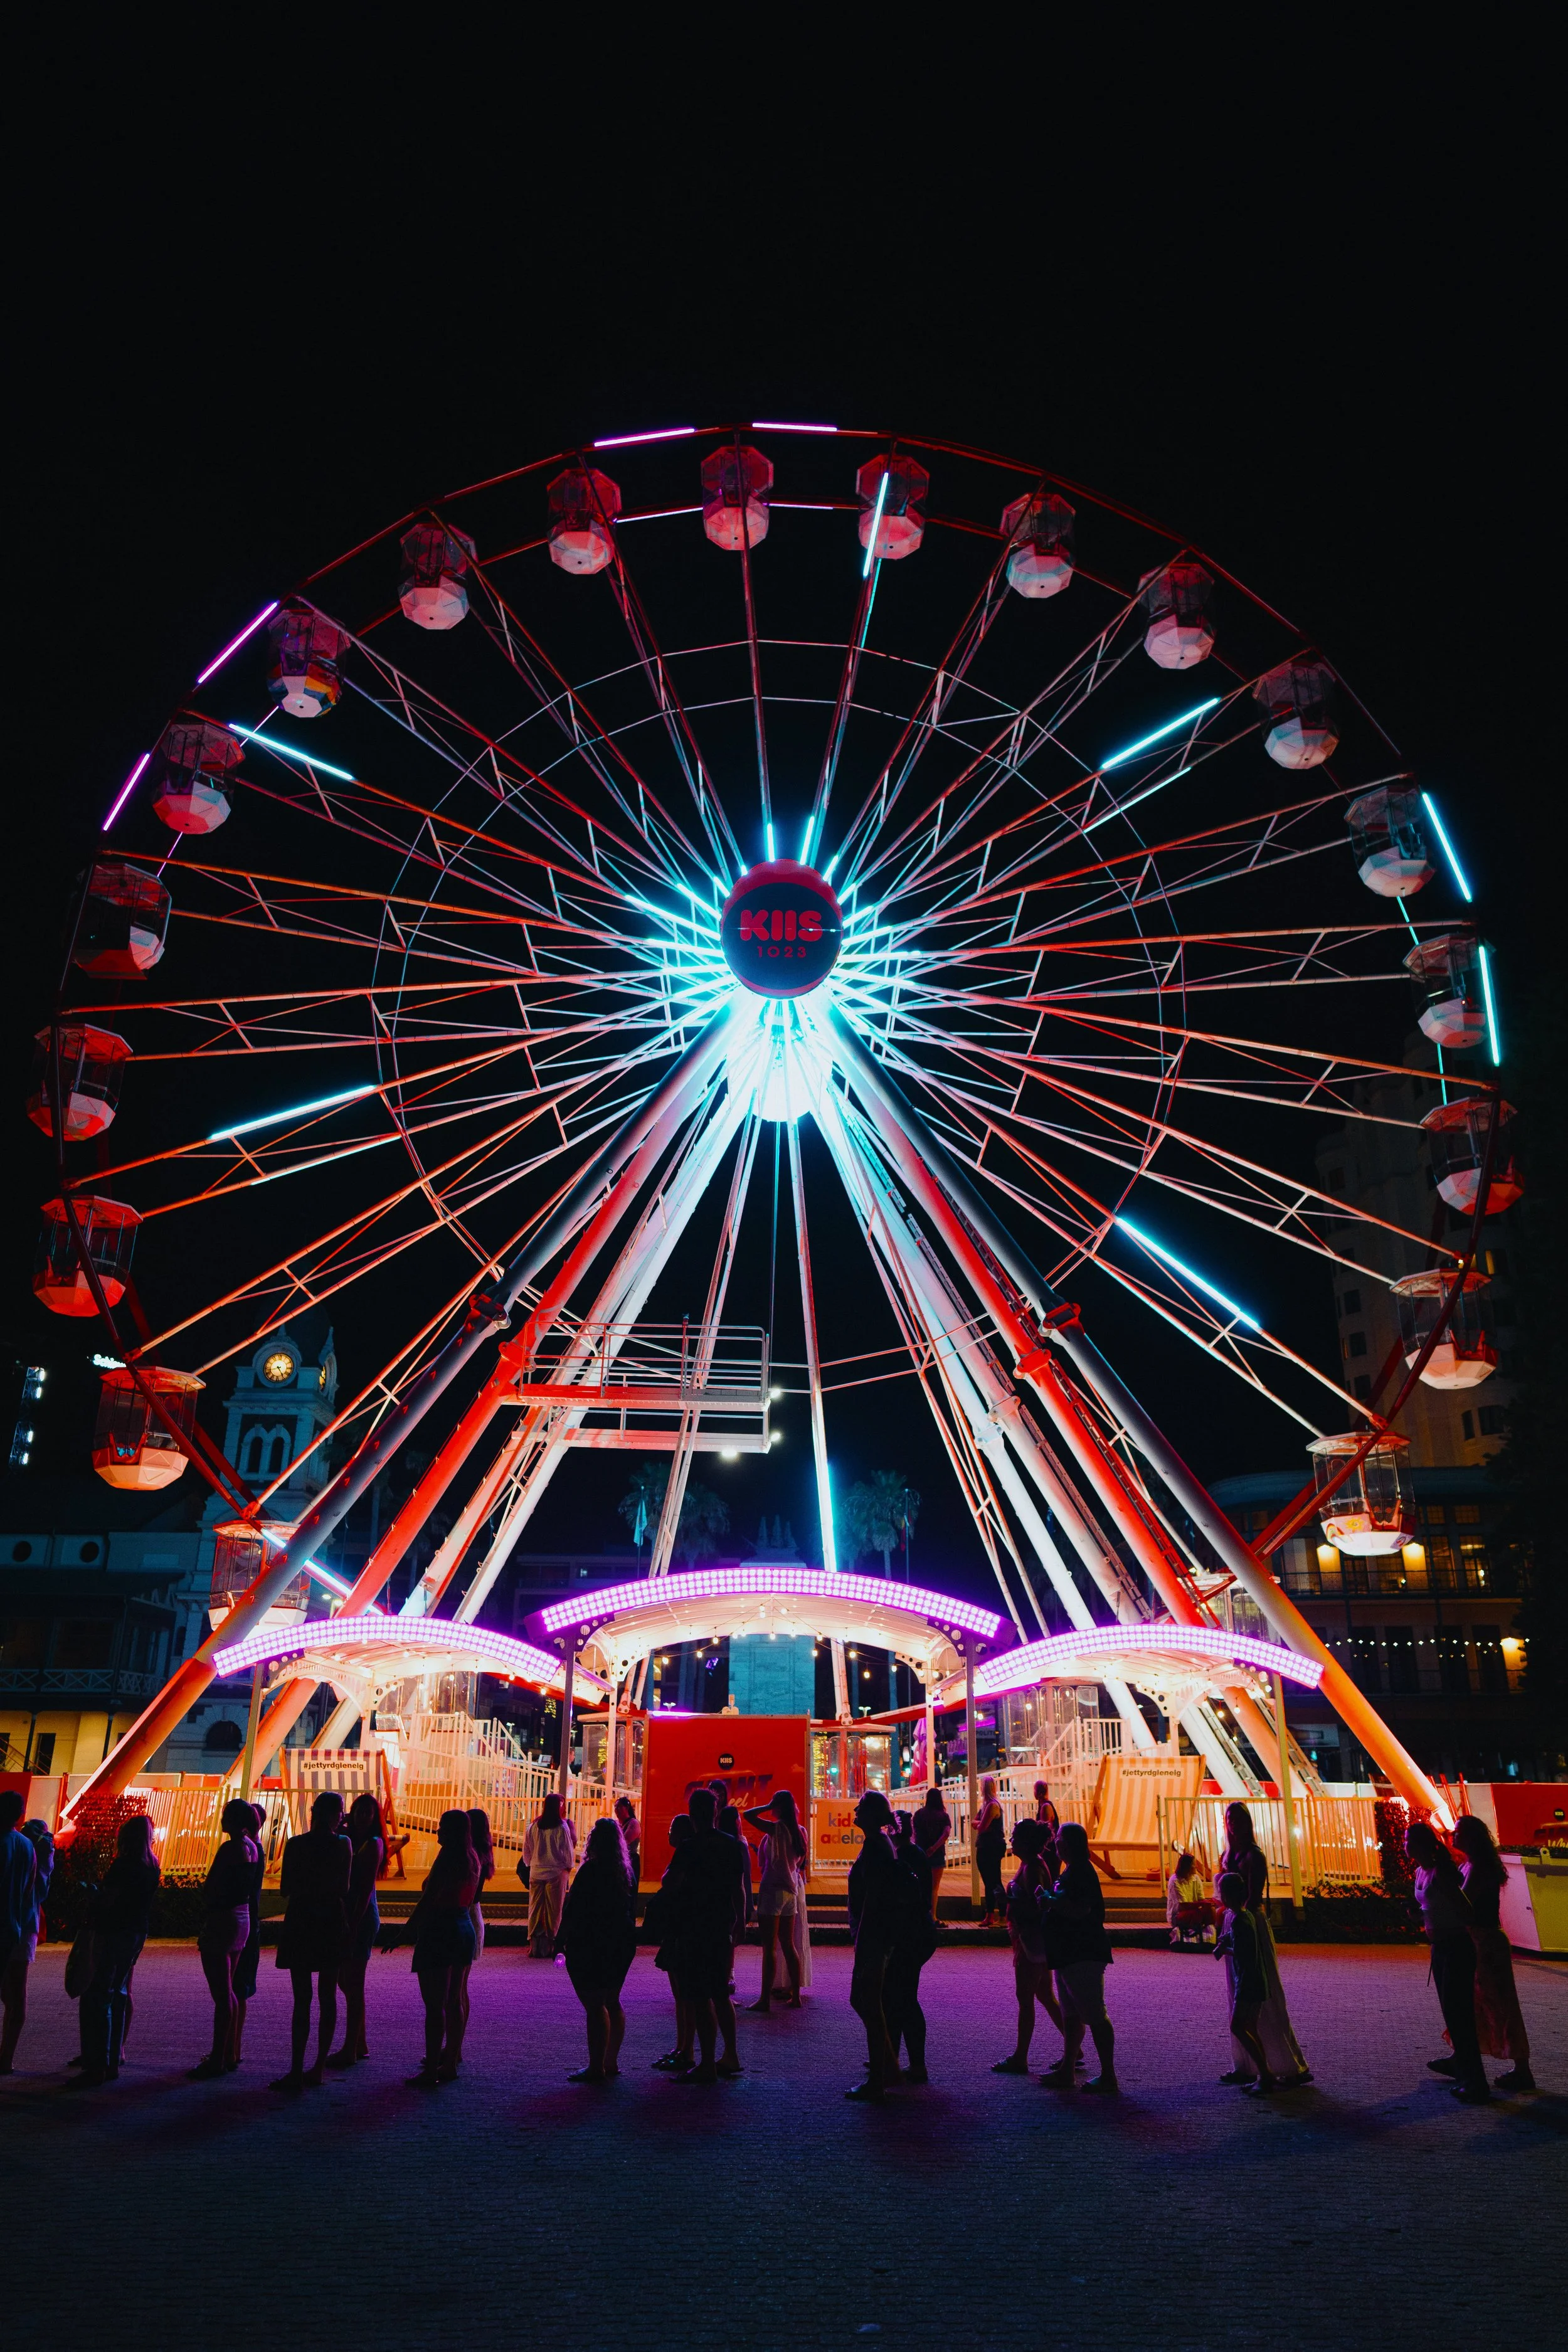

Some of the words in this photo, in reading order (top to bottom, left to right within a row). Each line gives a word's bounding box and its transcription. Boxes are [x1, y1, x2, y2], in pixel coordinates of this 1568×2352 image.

[740, 909, 823, 942] KIIS
[757, 946, 807, 958] 1023
[728, 1793, 749, 1807] eel
[820, 1829, 864, 1845] adela
